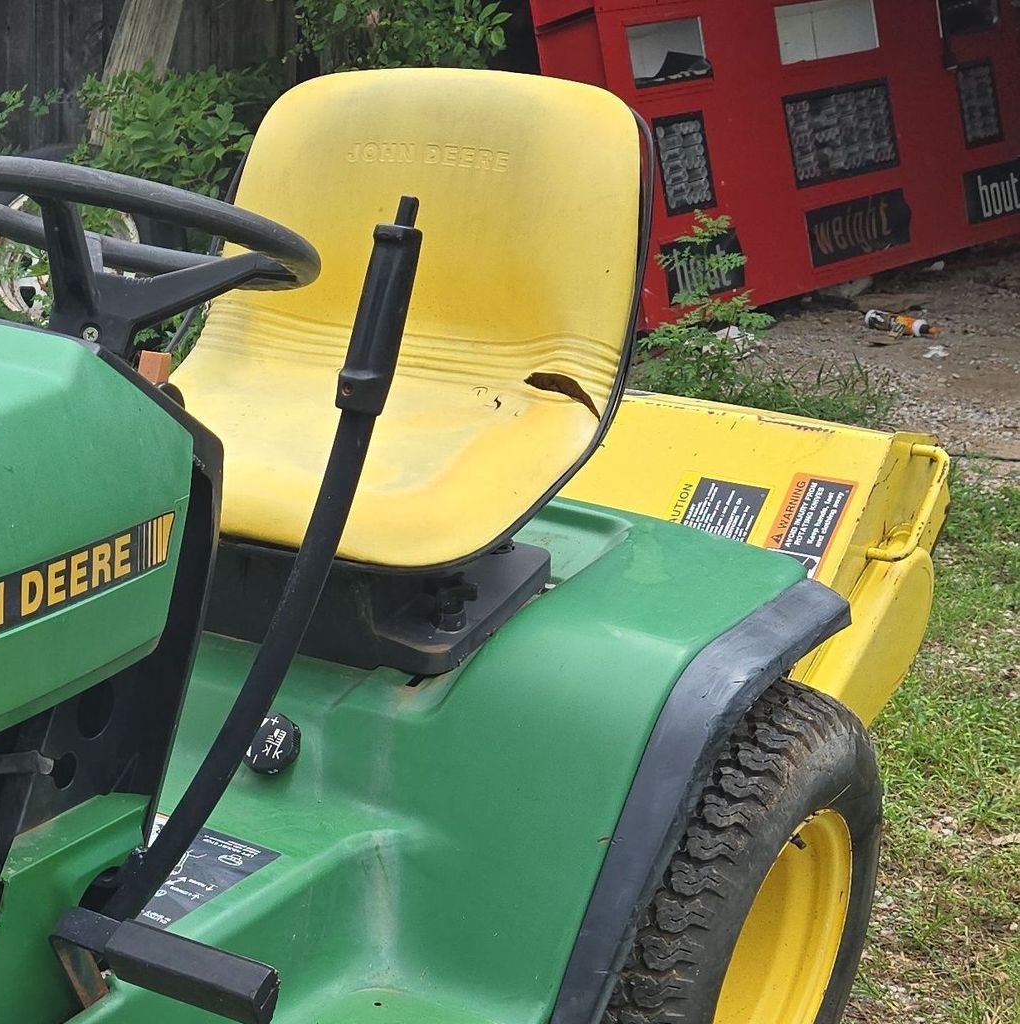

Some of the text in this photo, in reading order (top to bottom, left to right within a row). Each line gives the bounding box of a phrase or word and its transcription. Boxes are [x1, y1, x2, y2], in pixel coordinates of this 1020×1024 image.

[347, 141, 510, 173] JOHN DEERE
[977, 172, 1020, 218] bout
[814, 196, 892, 255] weight
[778, 481, 806, 529] WARNING
[784, 482, 818, 547] AVOID INJURY FROM
[794, 511, 814, 546] ROTATING
[21, 533, 133, 617] DEERE
